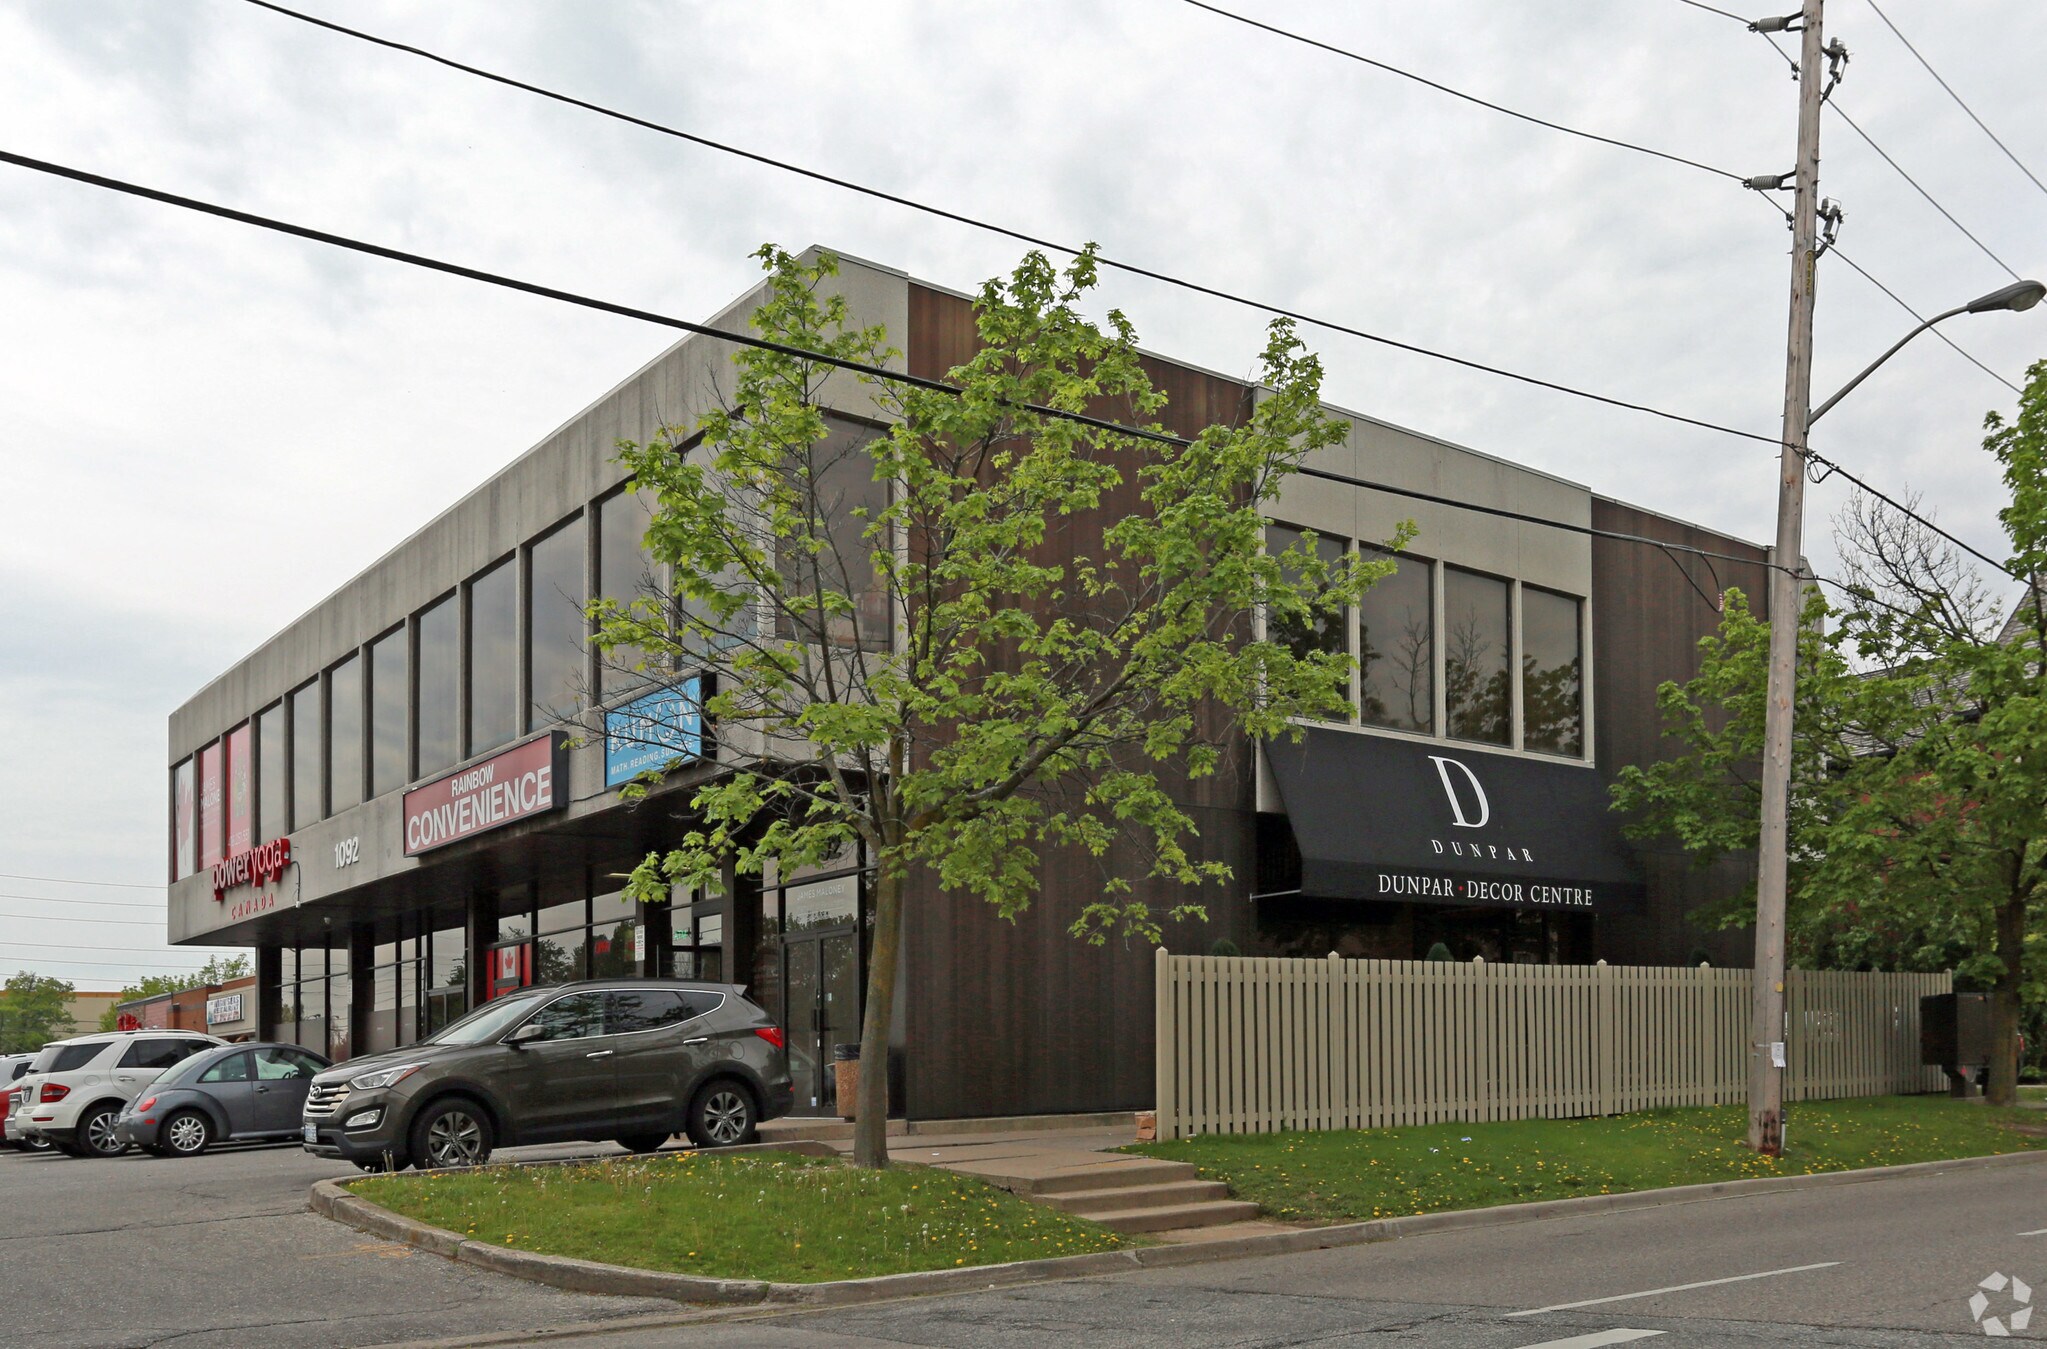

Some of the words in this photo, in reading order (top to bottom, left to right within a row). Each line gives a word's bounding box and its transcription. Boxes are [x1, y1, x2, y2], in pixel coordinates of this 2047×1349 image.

[451, 763, 495, 797] RAINBOW
[1427, 755, 1490, 828] D
[407, 765, 551, 850] CONVENIENCE
[334, 836, 359, 869] 1092
[1431, 839, 1533, 862] DUNPAR
[212, 850, 250, 901] power
[250, 838, 282, 888] yoga
[231, 892, 275, 921] CANADA
[1378, 874, 1454, 897] DUNPAR
[1466, 880, 1524, 902] DECOR
[1530, 885, 1593, 906] CENTRE
